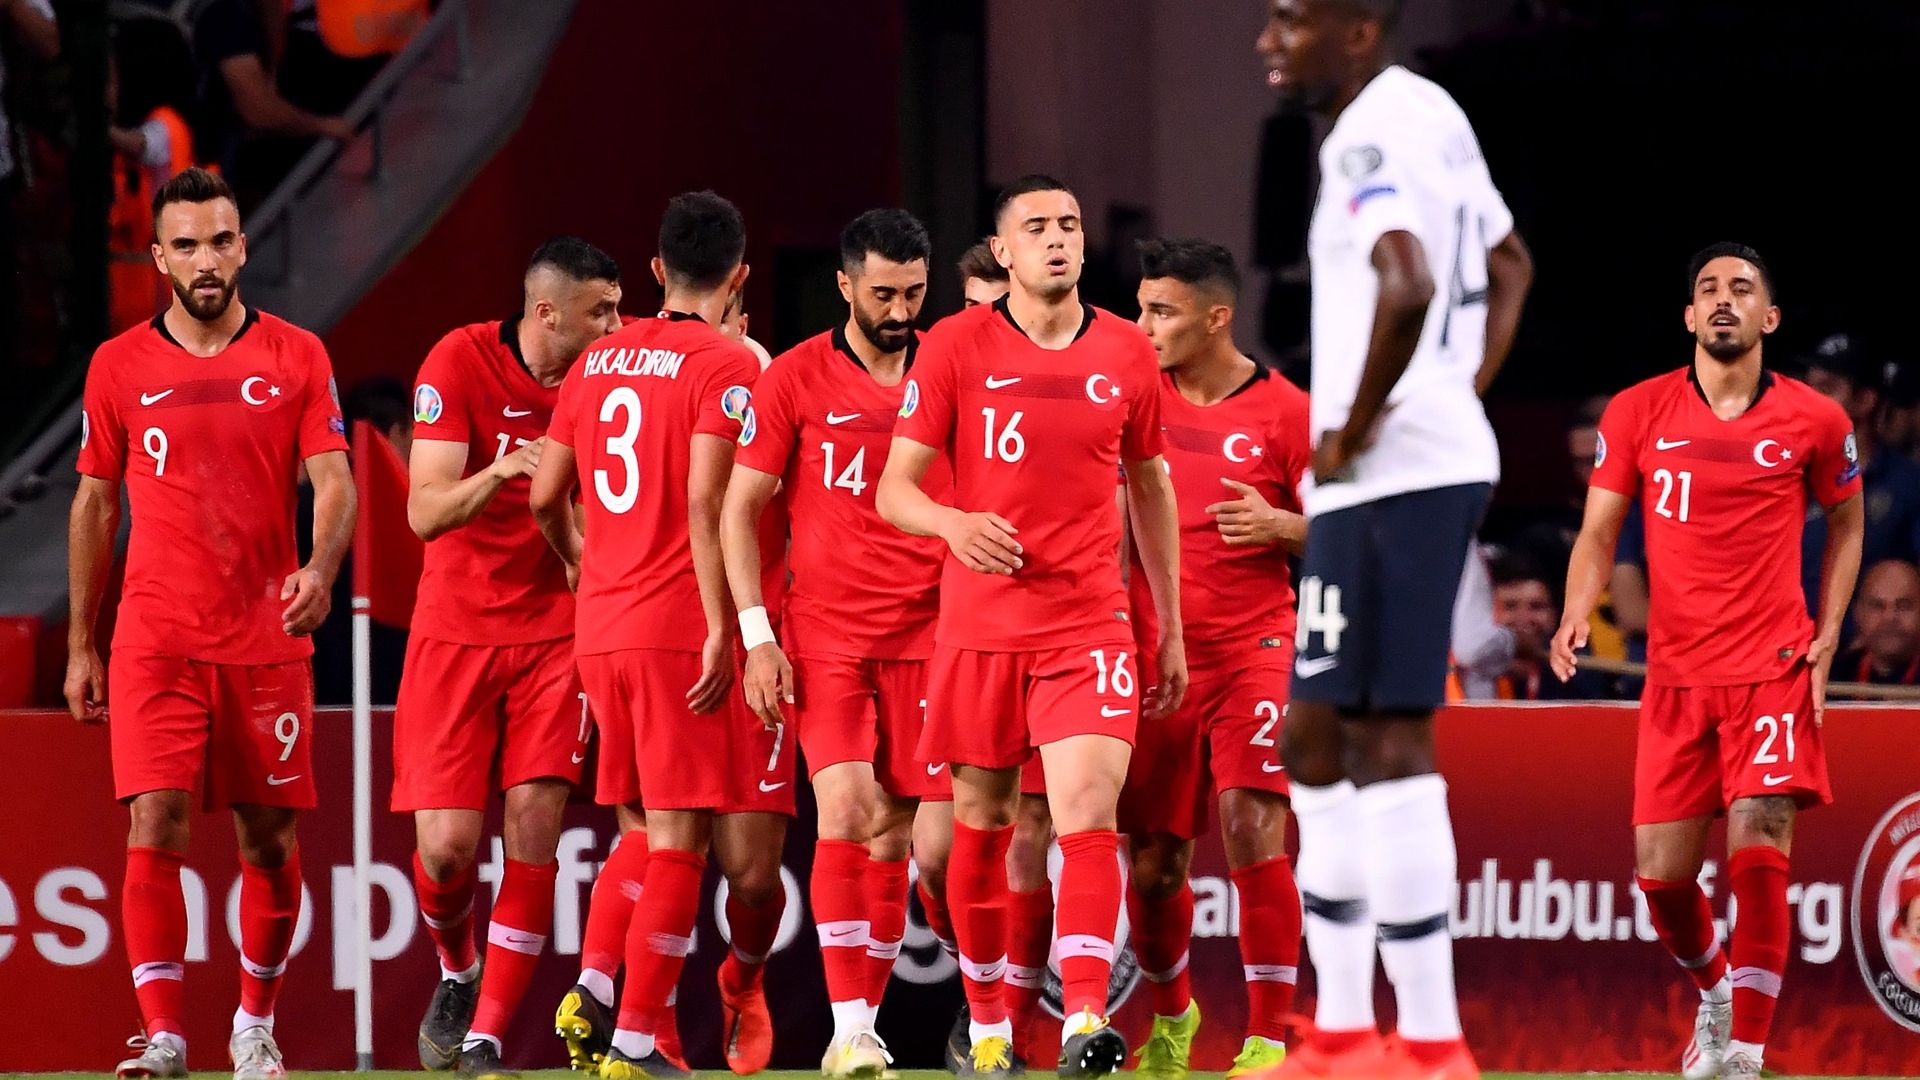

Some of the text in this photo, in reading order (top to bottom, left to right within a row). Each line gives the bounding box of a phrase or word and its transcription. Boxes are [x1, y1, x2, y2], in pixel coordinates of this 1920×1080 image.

[583, 347, 686, 380] H.KALDIRIM
[143, 427, 168, 477] 9
[593, 386, 642, 514] 3
[980, 406, 1025, 463] 16
[820, 441, 867, 496] 14
[1653, 468, 1692, 523] 21
[1295, 575, 1348, 653] 14
[1089, 649, 1134, 698] 16
[274, 712, 300, 761] 9
[1249, 700, 1290, 747] 2
[1752, 712, 1795, 766] 21
